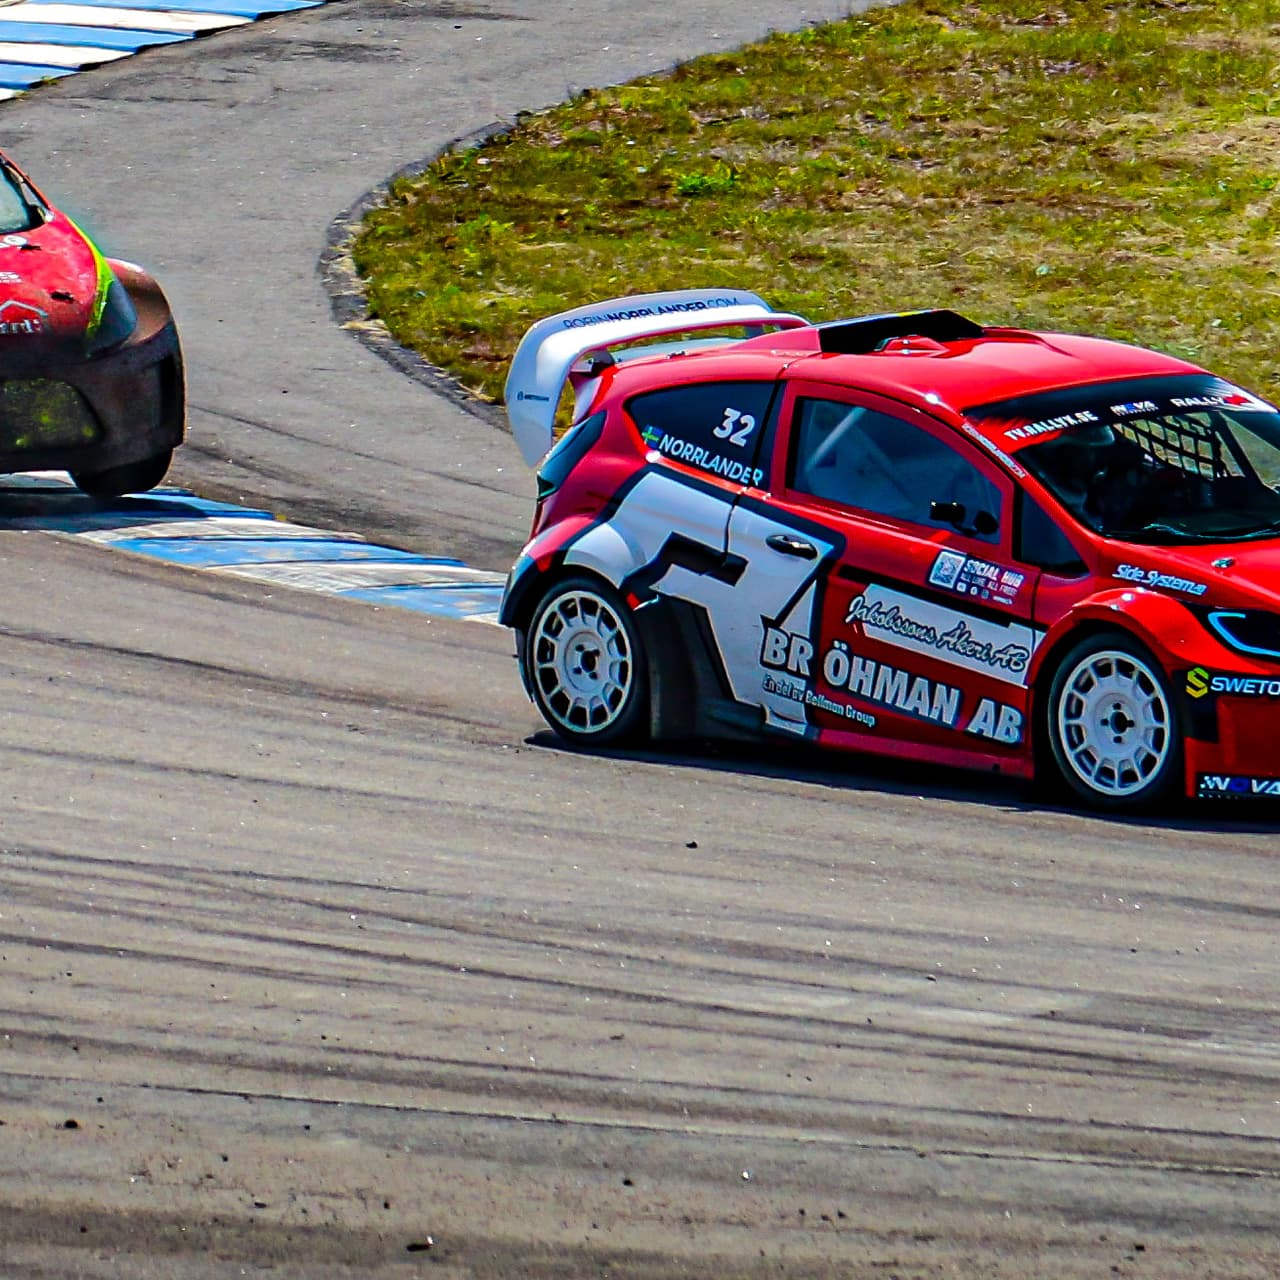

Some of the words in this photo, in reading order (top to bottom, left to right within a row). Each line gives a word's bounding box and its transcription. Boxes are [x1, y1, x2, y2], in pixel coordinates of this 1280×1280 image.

[712, 407, 756, 448] 32
[658, 433, 764, 487] NORRLANDER
[963, 559, 1000, 581] SOCIAL
[1000, 570, 1025, 589] HUB
[1115, 563, 1145, 580] Side
[989, 642, 1032, 673] AB
[762, 627, 815, 677] BR
[823, 640, 962, 726] ÖHMAN
[966, 697, 1022, 745] AB
[845, 704, 877, 729] Group
